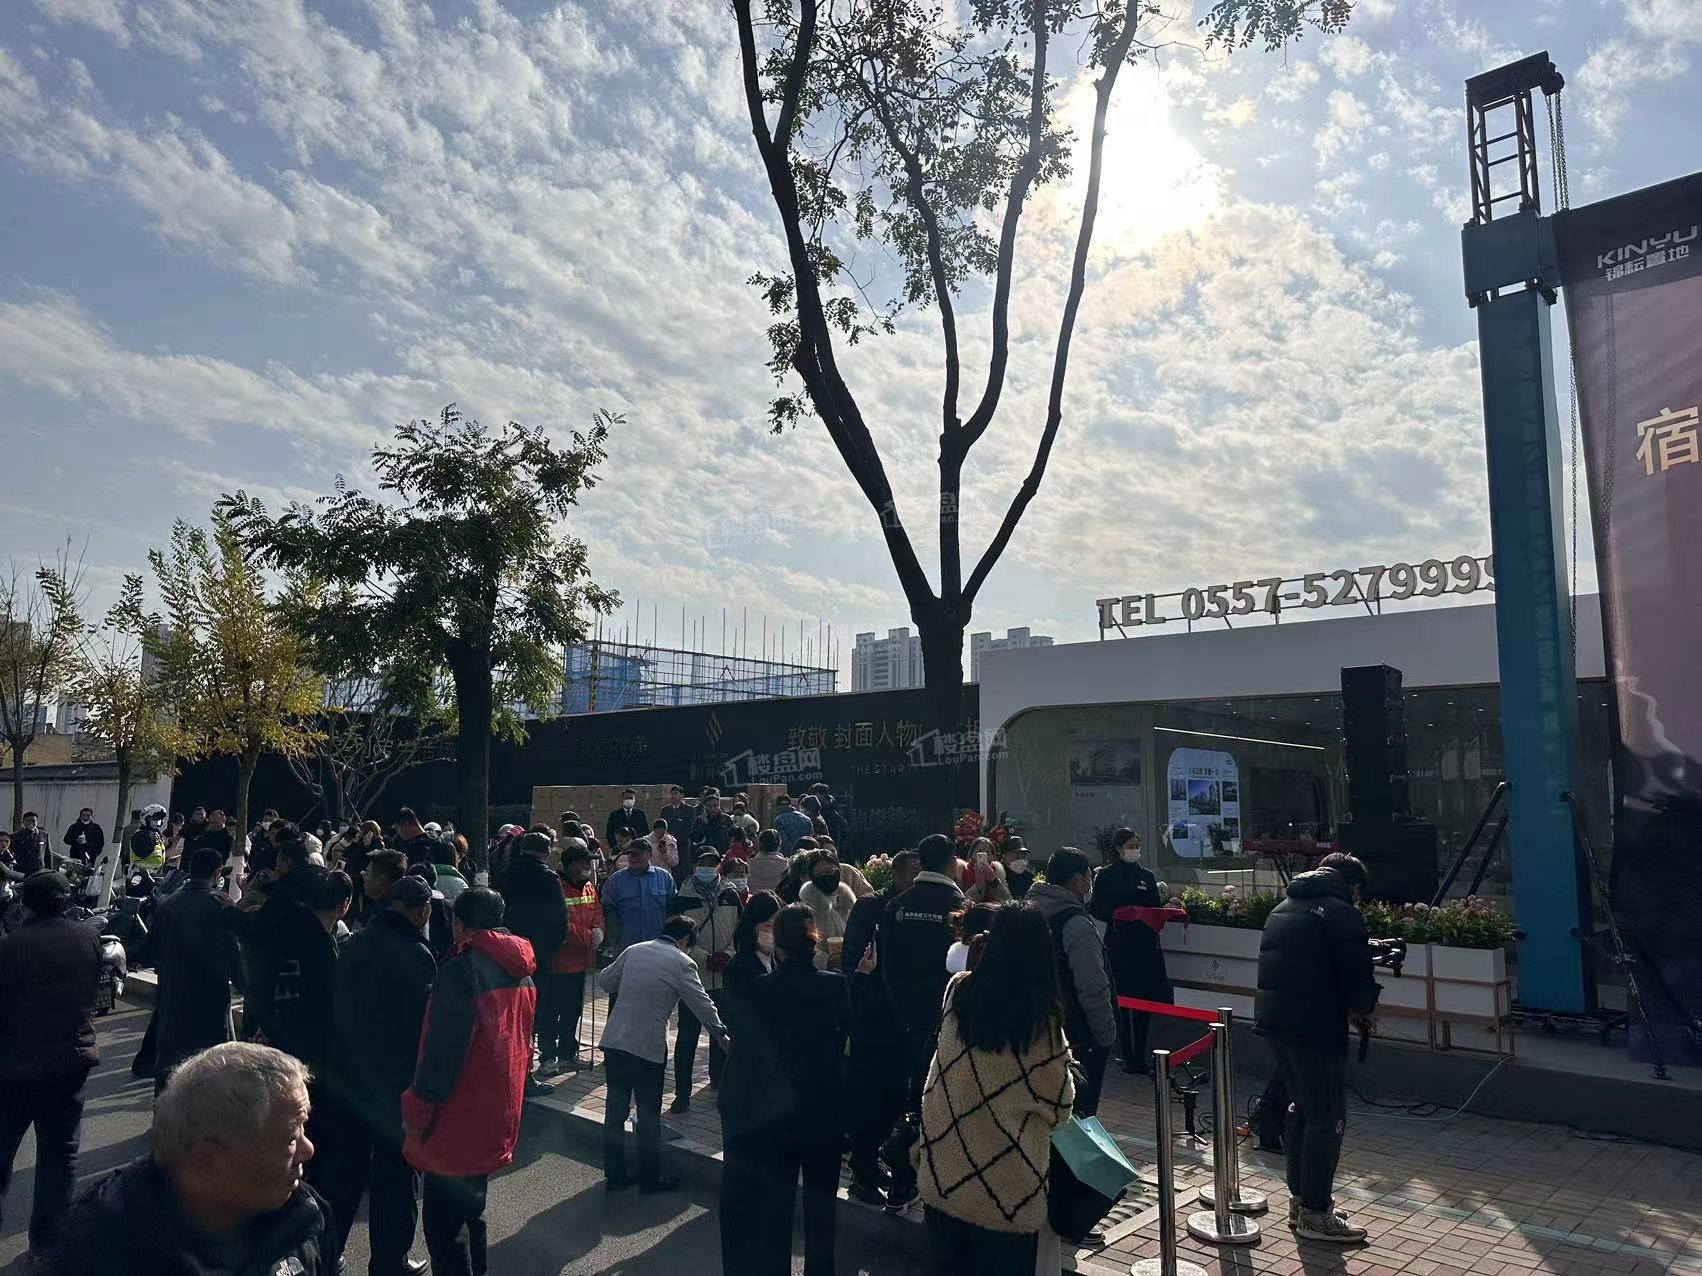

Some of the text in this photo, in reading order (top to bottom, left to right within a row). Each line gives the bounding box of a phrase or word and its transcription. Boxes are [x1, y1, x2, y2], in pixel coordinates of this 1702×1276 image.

[1597, 225, 1698, 268] KINYU
[1635, 406, 1700, 476] 宿
[1096, 593, 1166, 629] TEL
